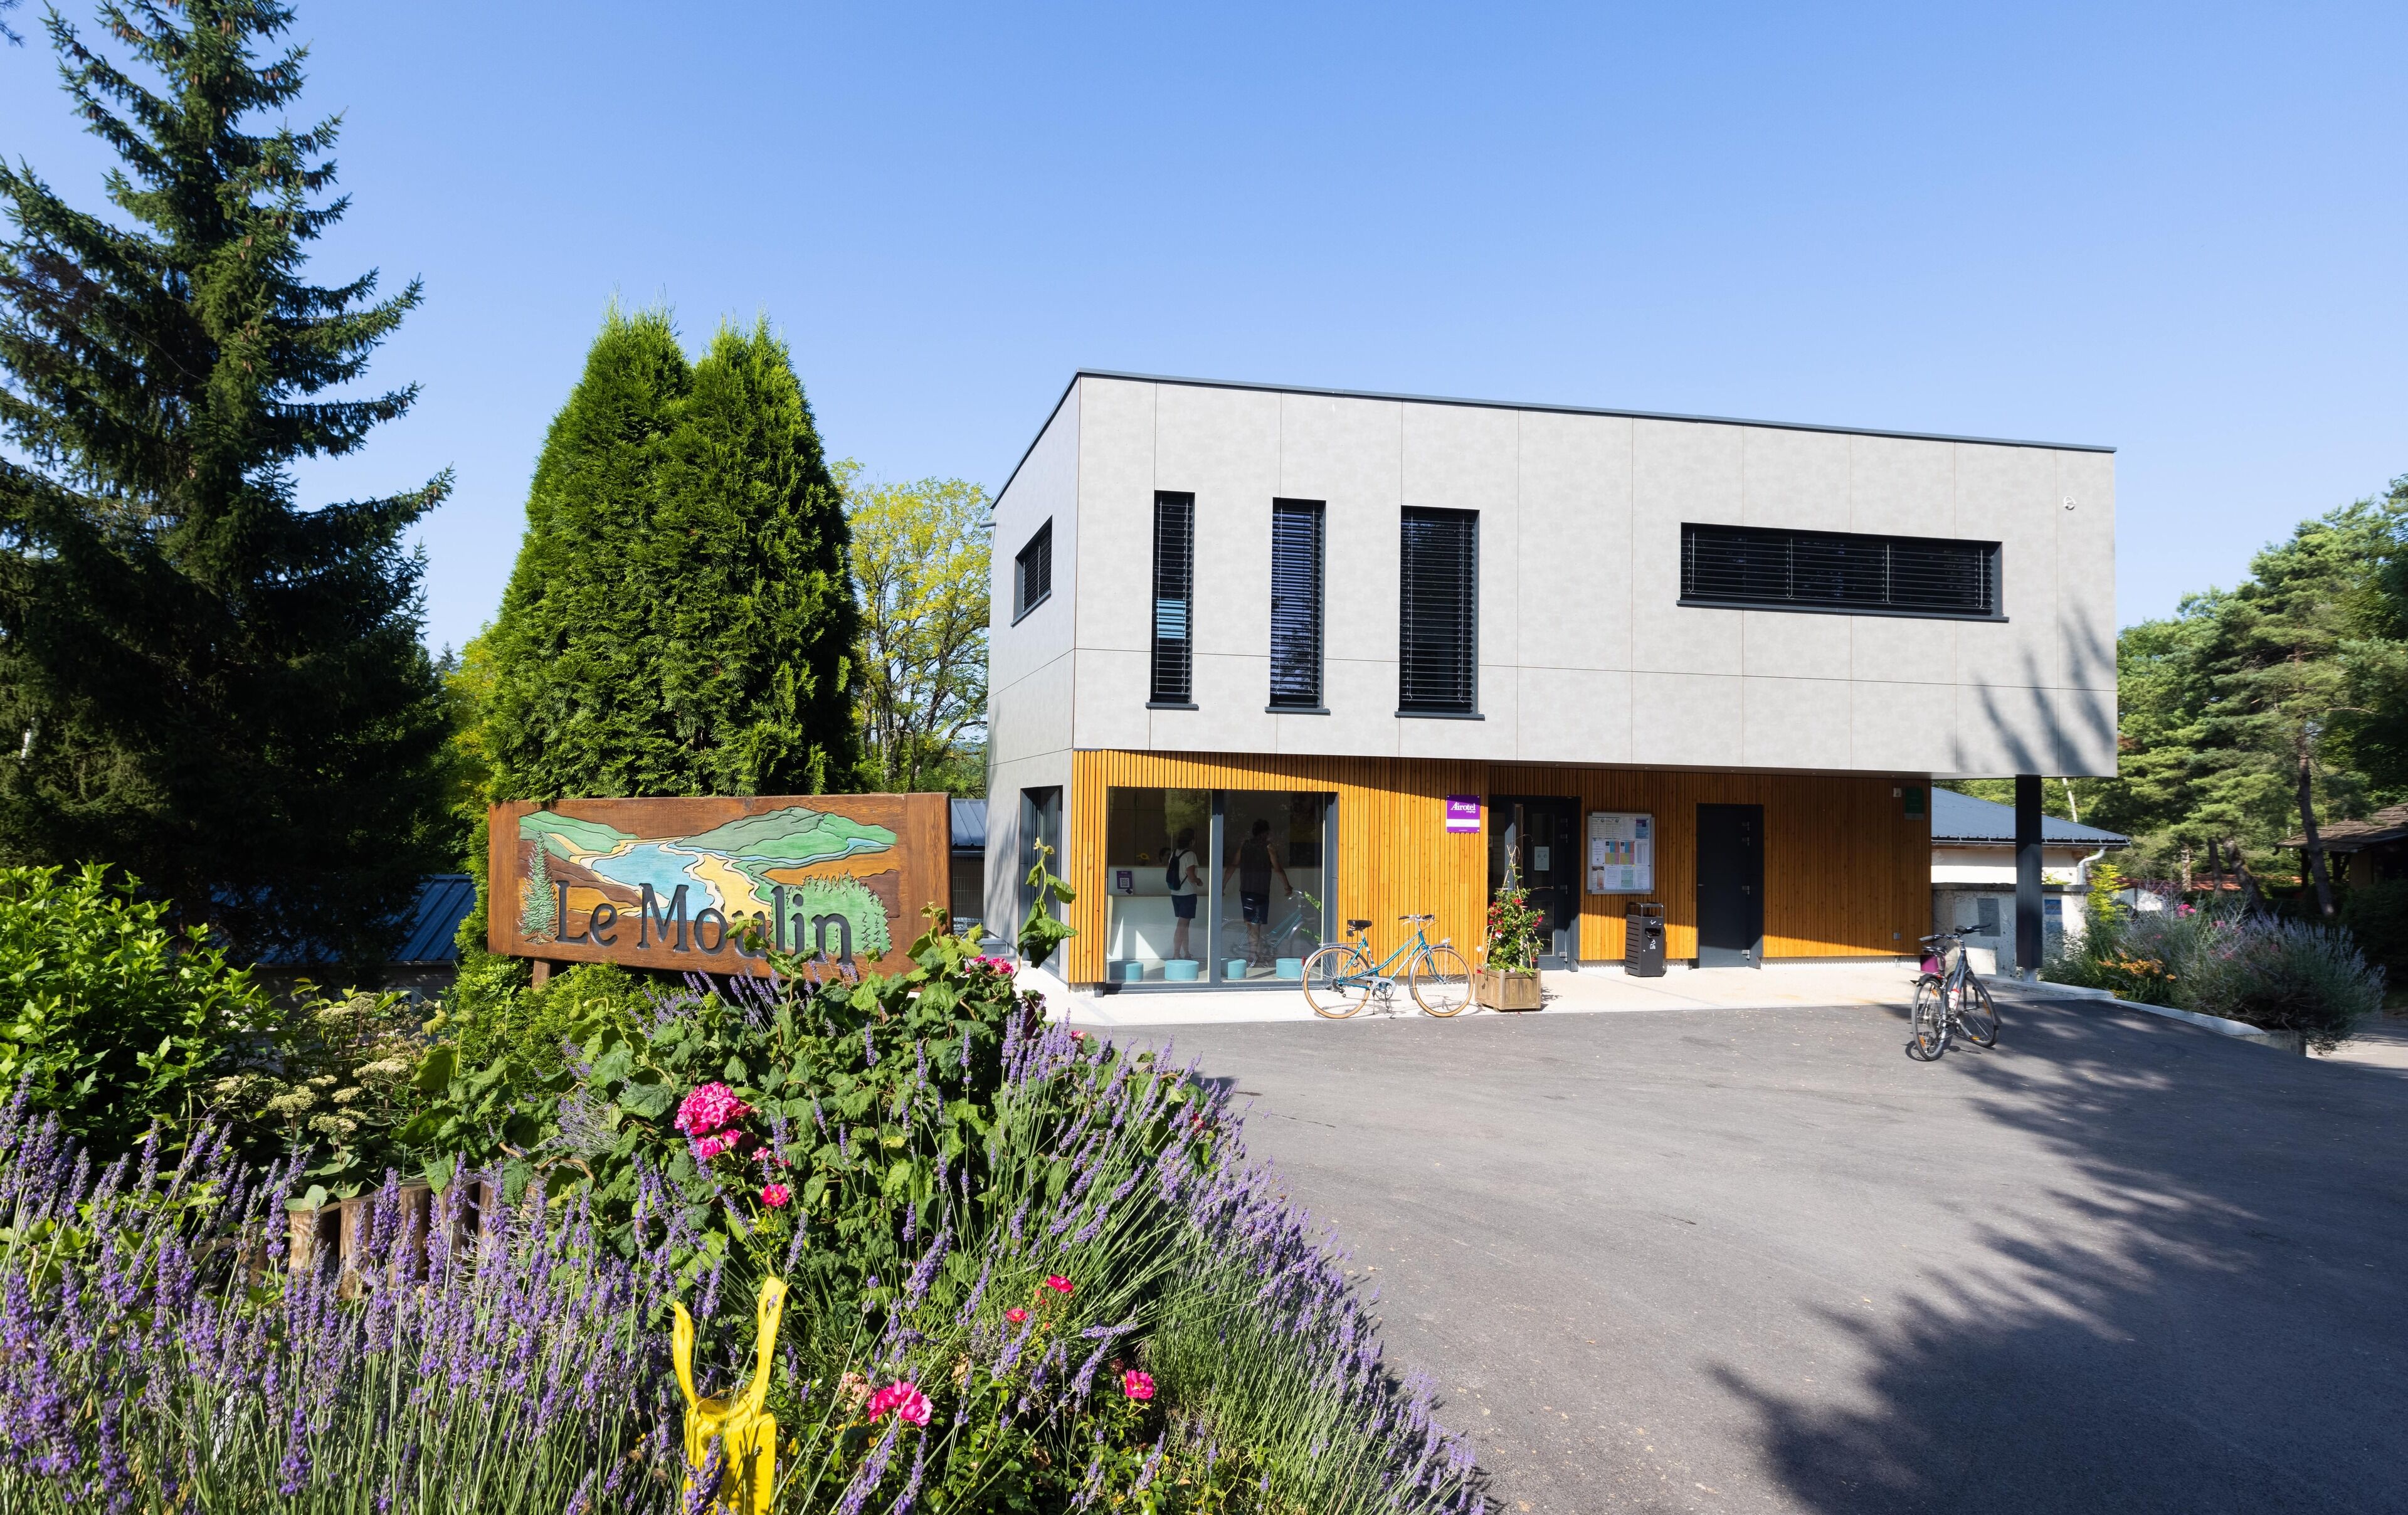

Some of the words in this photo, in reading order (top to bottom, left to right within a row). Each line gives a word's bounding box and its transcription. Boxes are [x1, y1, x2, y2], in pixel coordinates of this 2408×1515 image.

[1450, 801, 1476, 811] Airotel
[555, 880, 618, 947] Le
[636, 882, 856, 966] Moulin
